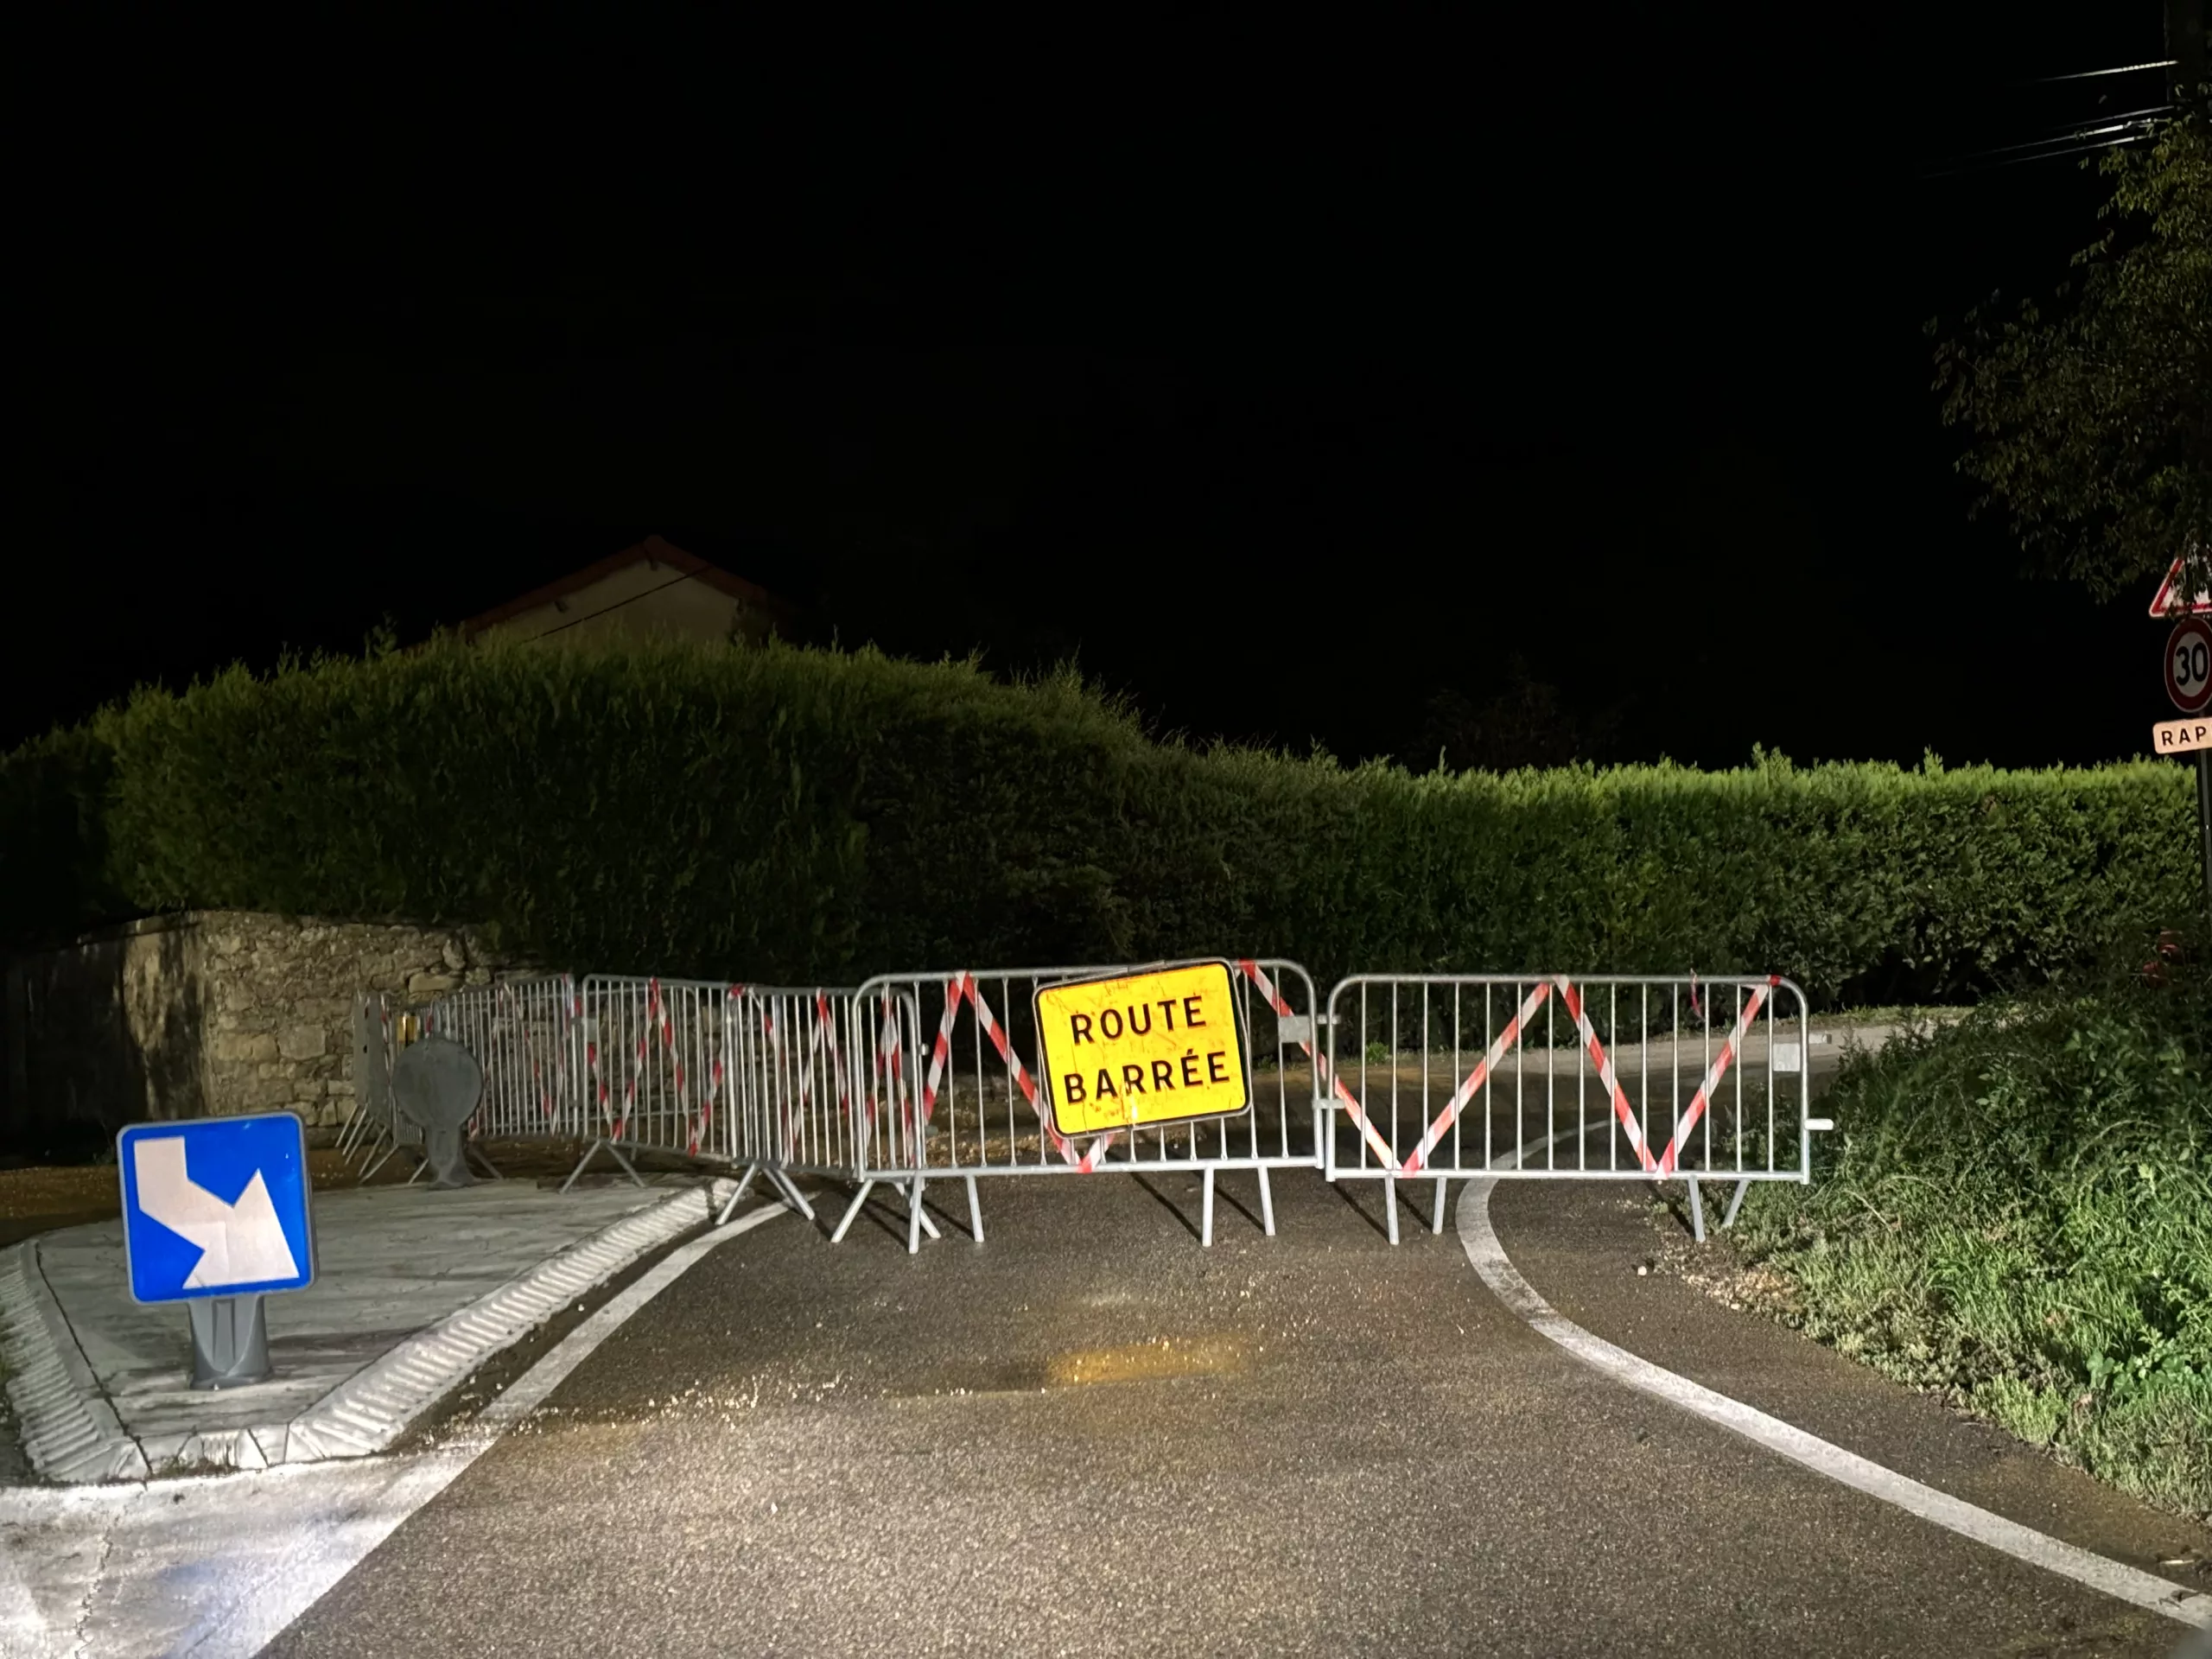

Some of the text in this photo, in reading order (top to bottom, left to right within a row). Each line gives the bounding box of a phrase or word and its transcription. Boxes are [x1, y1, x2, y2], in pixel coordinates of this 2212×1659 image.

[2176, 641, 2209, 686] 30
[1070, 995, 1207, 1046] ROUTE
[1064, 1048, 1230, 1105] BARRÉE
